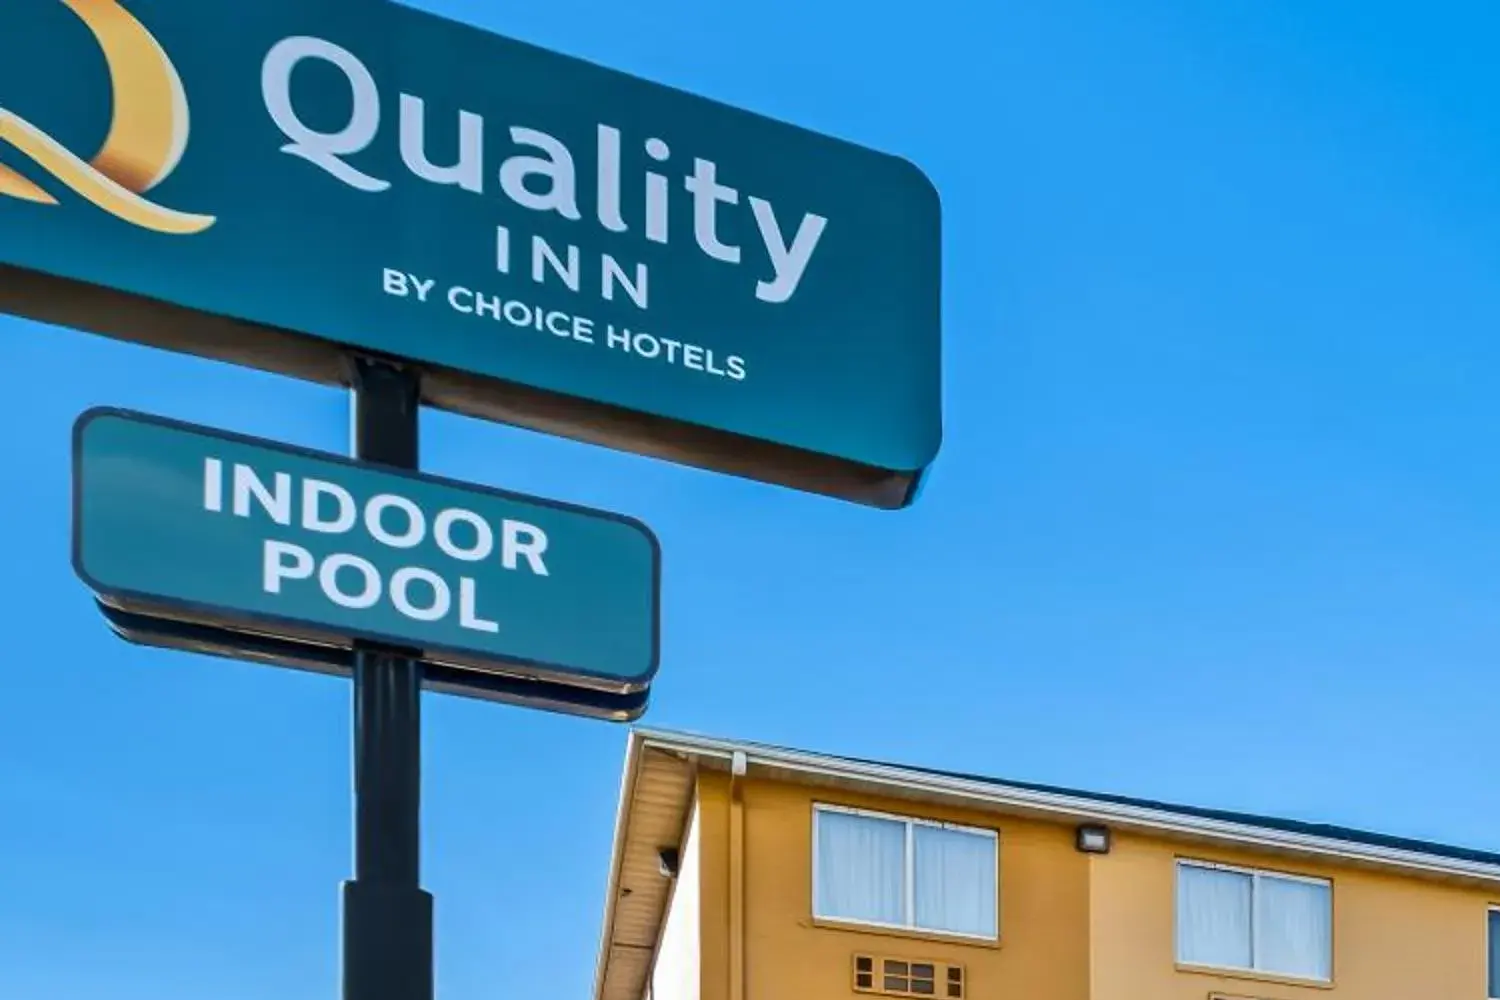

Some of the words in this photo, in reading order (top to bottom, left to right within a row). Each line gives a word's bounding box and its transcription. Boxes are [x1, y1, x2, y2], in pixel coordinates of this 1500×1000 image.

[261, 36, 828, 303] Quality
[497, 225, 648, 309] INN
[382, 268, 434, 301] BY
[447, 286, 593, 343] CHOICE
[607, 325, 746, 380] HOTELS
[204, 457, 549, 576] INDOOR
[263, 539, 499, 633] POOL
